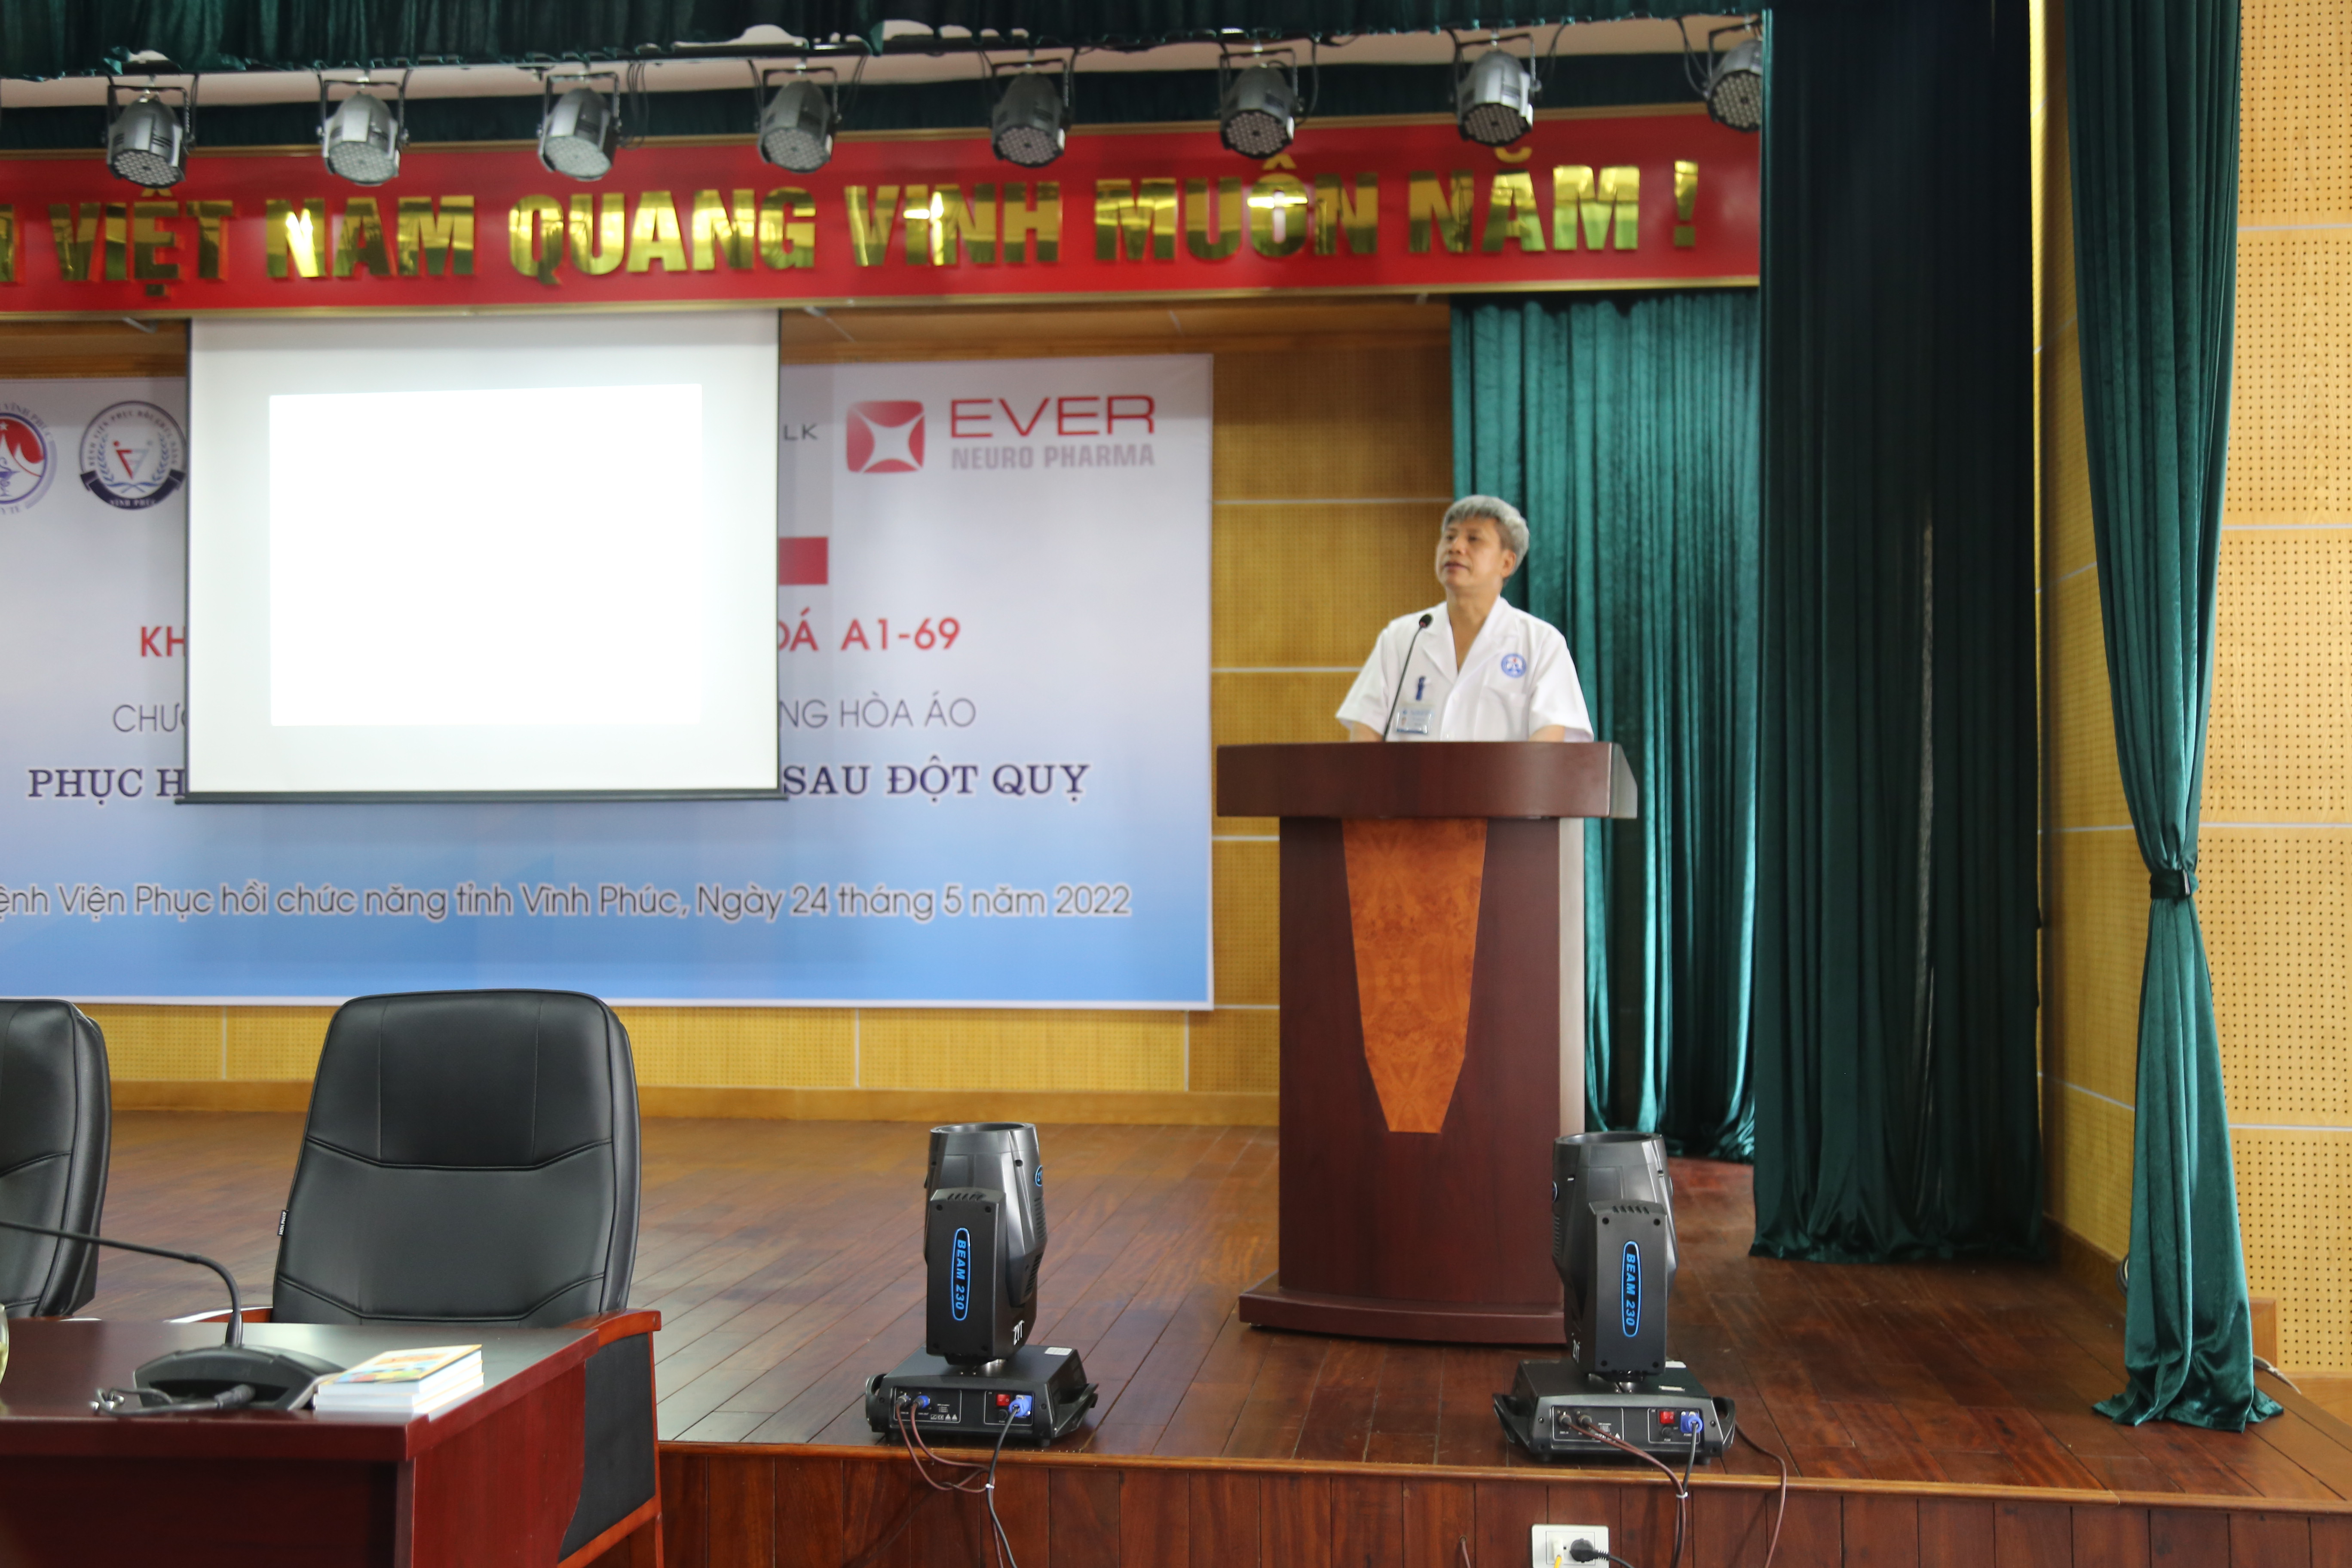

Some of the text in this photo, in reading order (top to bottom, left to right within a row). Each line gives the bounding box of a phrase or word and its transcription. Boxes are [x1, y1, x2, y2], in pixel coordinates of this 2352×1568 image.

[49, 188, 233, 296] VIỆT
[266, 196, 474, 278] NAM
[508, 187, 816, 285] QUANG
[843, 181, 1059, 266] VINH
[1096, 153, 1378, 260] MUÔN
[1409, 147, 1640, 254] NĂM
[784, 423, 818, 441] LK
[951, 394, 1155, 438] EVER
[951, 444, 1155, 470] NEURO PHARMA
[840, 616, 960, 651] A1-69
[113, 702, 187, 732] CHƯ
[841, 691, 913, 728] HÒA
[925, 691, 976, 727] ÁO
[28, 768, 143, 805] PHỤC
[783, 755, 1090, 802] SAU ĐỘT QUỴ
[59, 885, 125, 919] Viện
[137, 885, 212, 919] Phục
[223, 881, 267, 913] hồi
[277, 884, 356, 913] chức
[366, 885, 445, 920] năng
[456, 882, 511, 913] tỉnh
[521, 885, 589, 913] Vĩnh
[601, 885, 689, 916] Phúc,
[698, 884, 783, 920] Ngày
[792, 886, 828, 913] 24
[838, 885, 932, 920] tháng
[944, 886, 962, 914] 5
[972, 886, 1044, 914] năm
[1056, 886, 1130, 914] 2022
[956, 1239, 966, 1310] BEAM 230
[1626, 1253, 1635, 1326] BEAM 230
